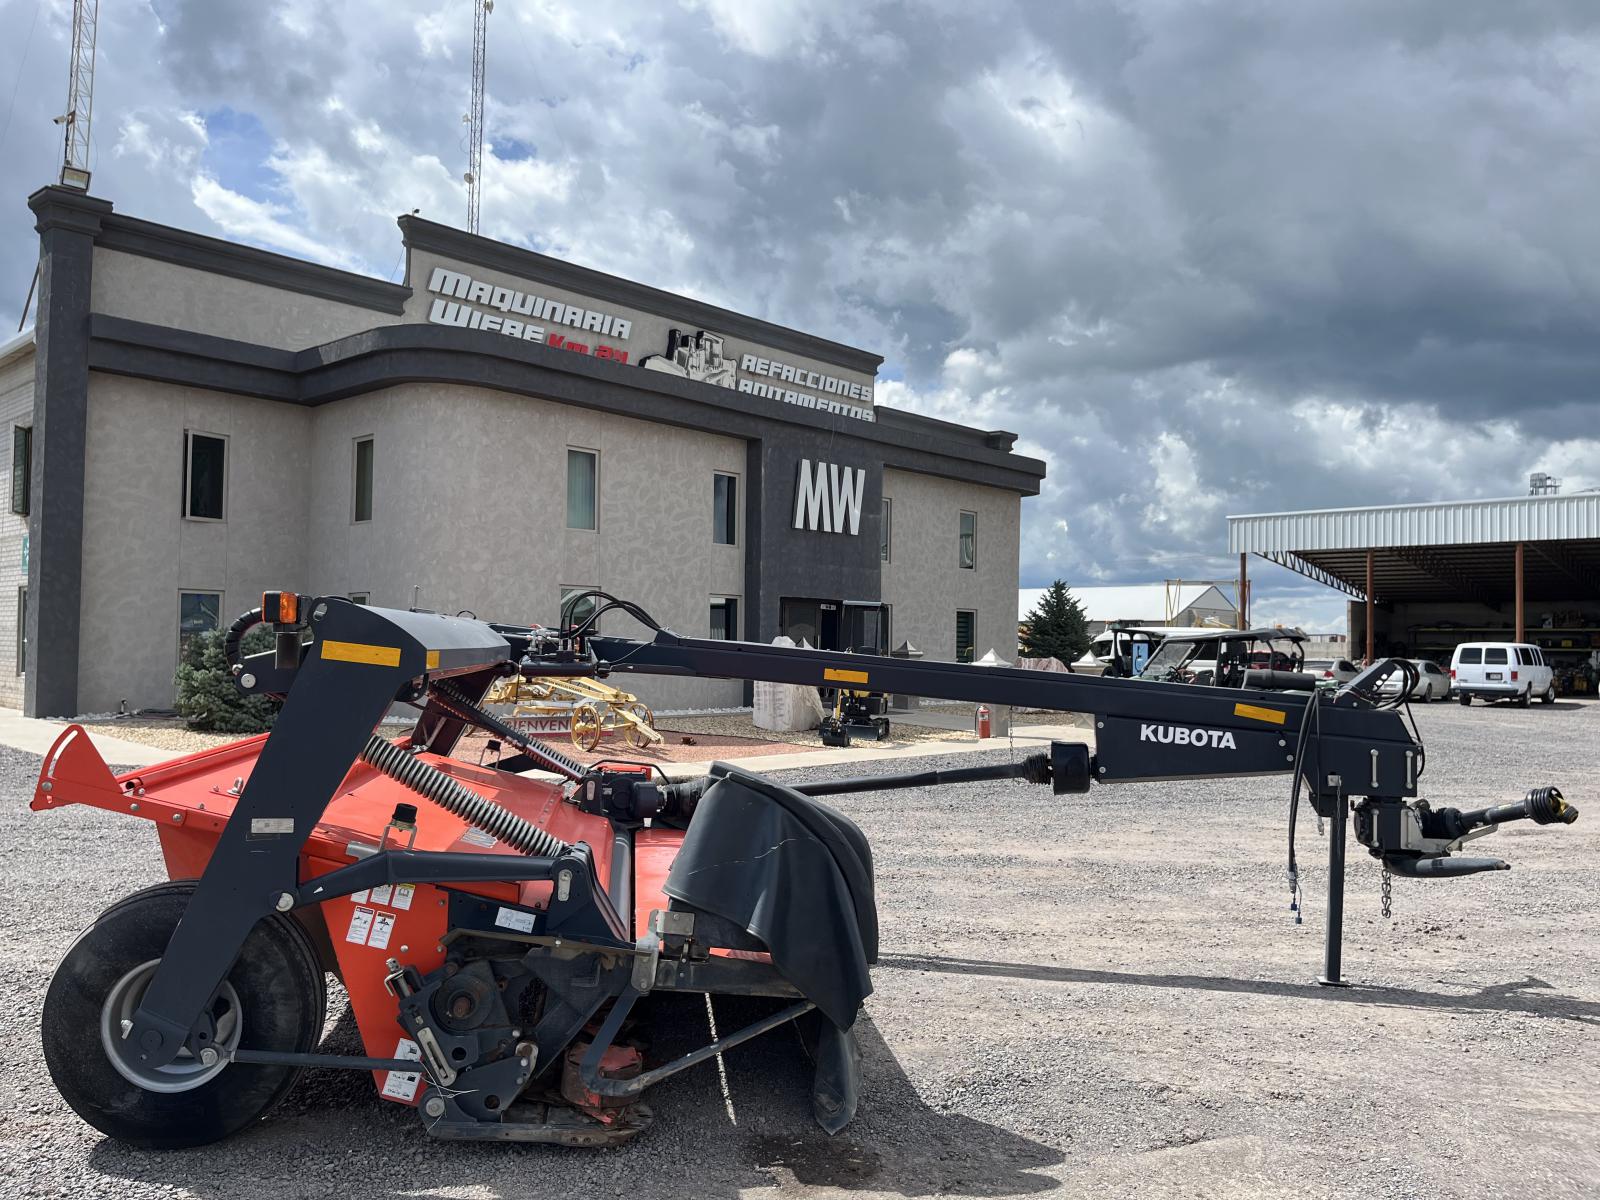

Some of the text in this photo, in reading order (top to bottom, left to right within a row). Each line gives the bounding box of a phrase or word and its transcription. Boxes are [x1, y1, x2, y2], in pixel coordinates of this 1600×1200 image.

[428, 267, 632, 340] MAQUINARIA
[429, 298, 545, 343] WIEBE
[548, 333, 589, 354] Km
[741, 354, 873, 401] REFACCIONES
[793, 458, 866, 536] MW
[1140, 723, 1237, 749] KUBOTA
